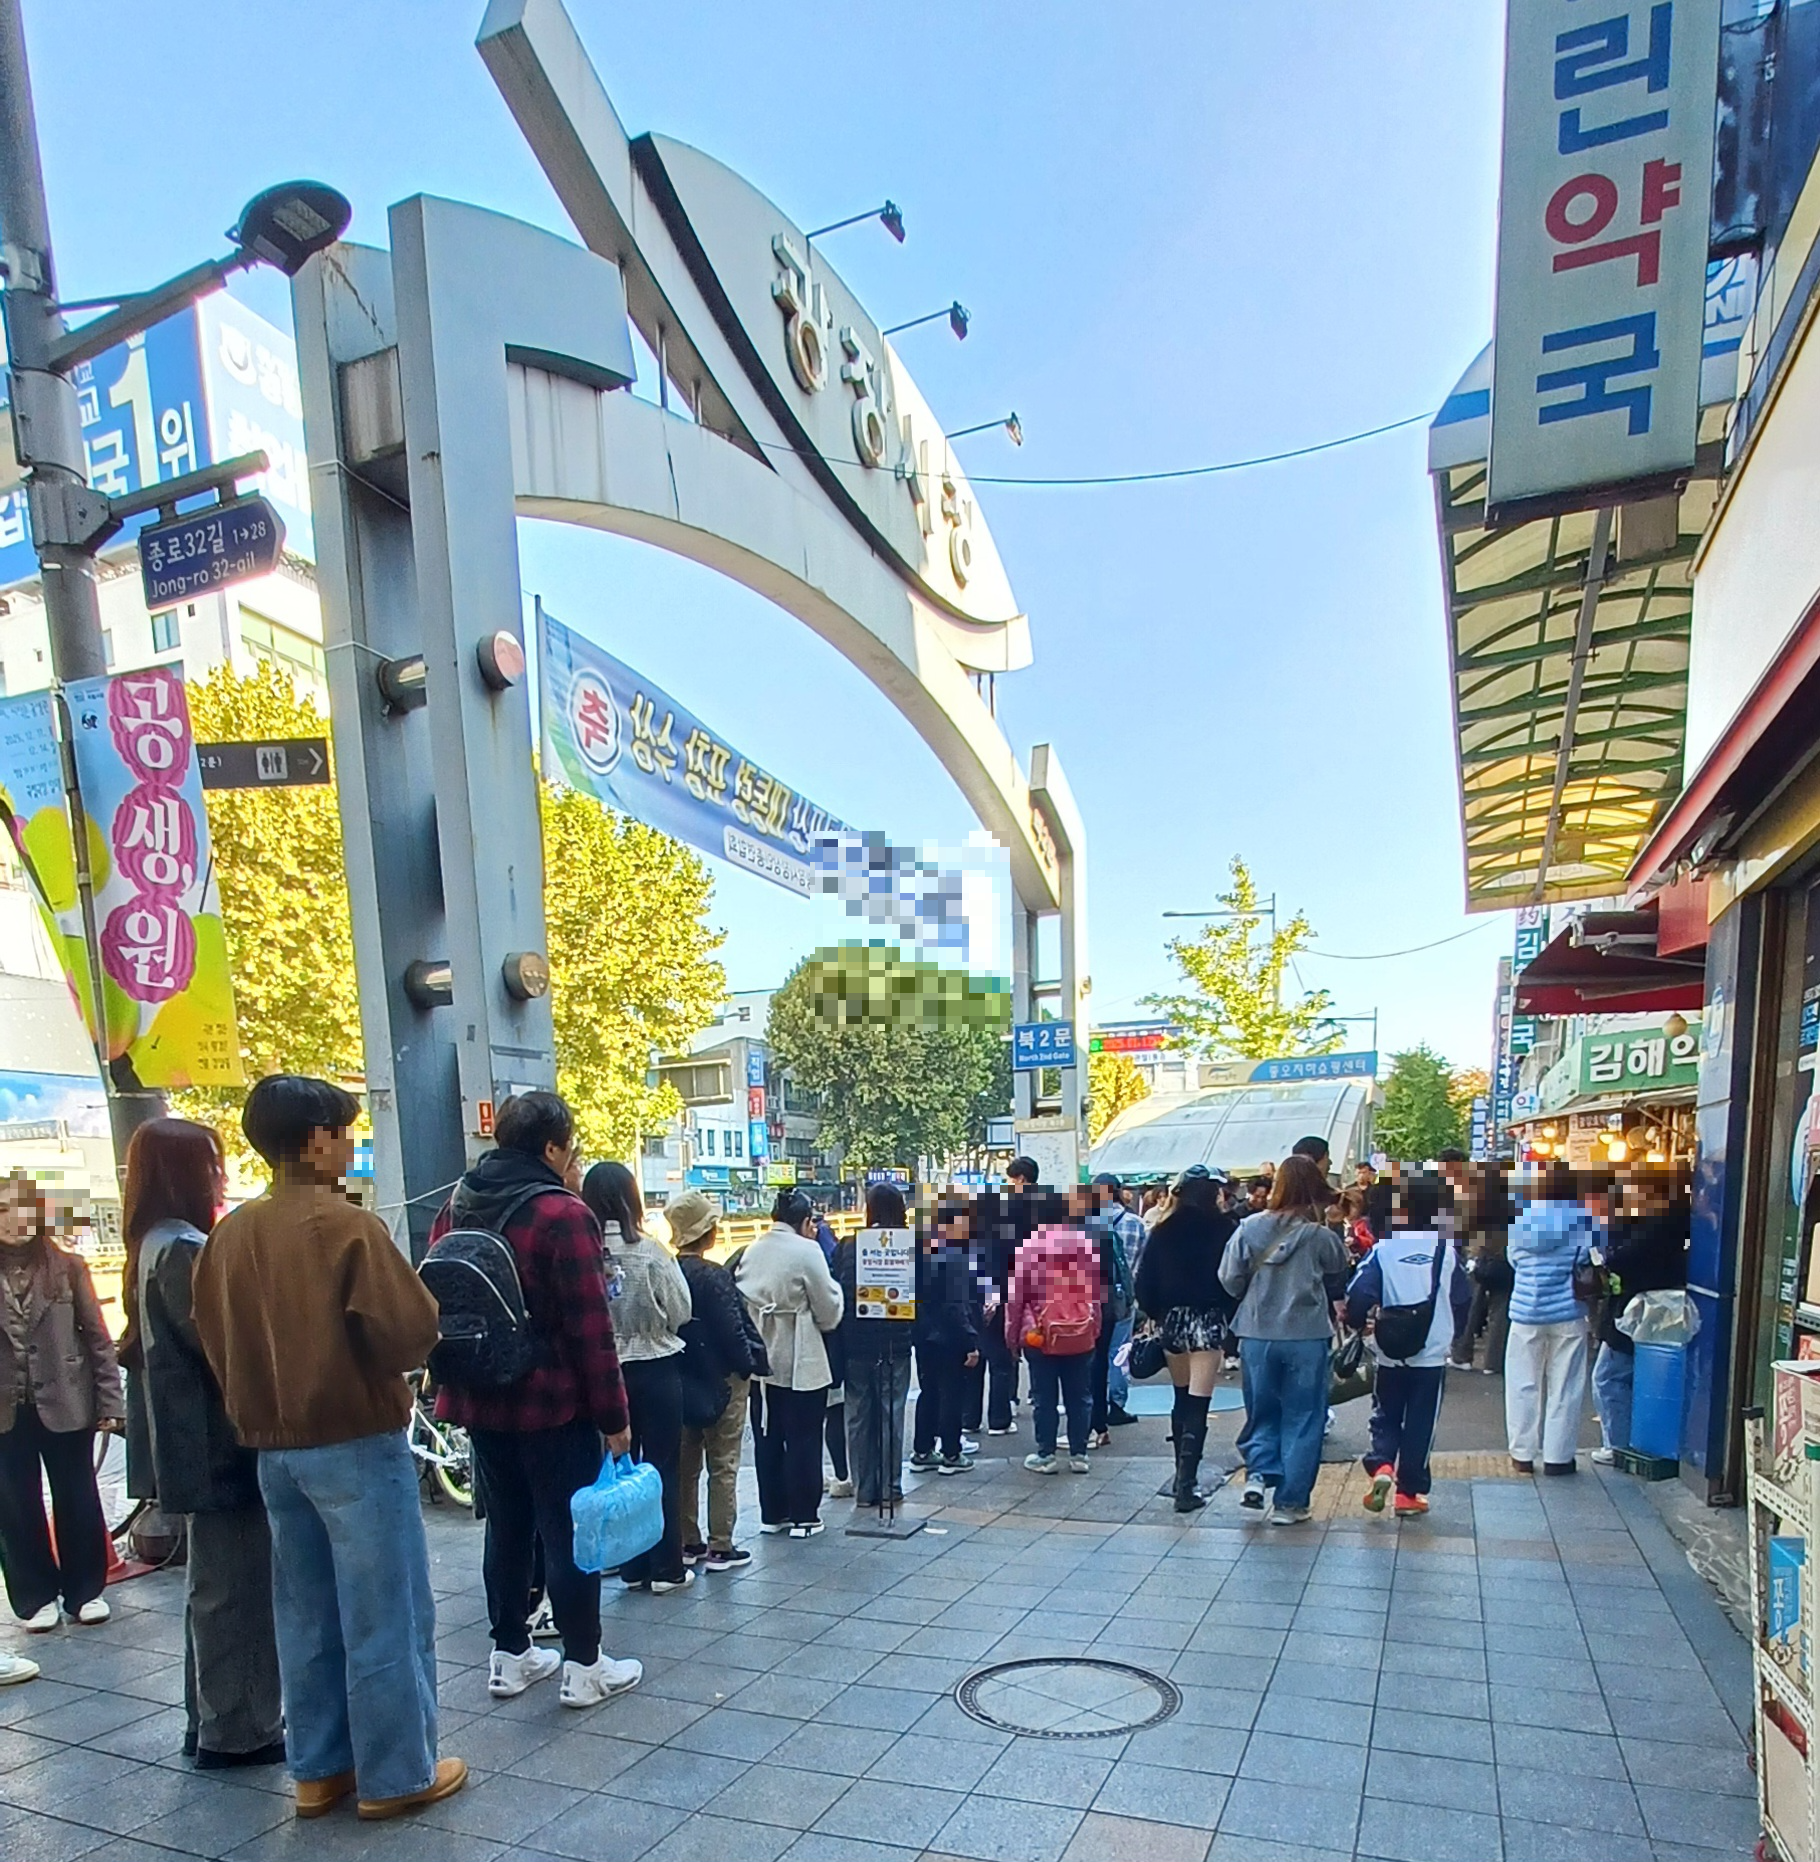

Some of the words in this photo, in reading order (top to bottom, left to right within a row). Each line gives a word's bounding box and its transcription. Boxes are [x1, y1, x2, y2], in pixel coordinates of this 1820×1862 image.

[1536, 0, 1682, 436] 린약국
[772, 231, 974, 590] 광장시장
[147, 520, 225, 572] 종로32길
[151, 570, 209, 598] Jong-ro
[211, 551, 256, 581] 32-gil
[1018, 1053, 1039, 1062] North
[1039, 1052, 1052, 1061] 2nd
[1052, 1051, 1070, 1060] Gate
